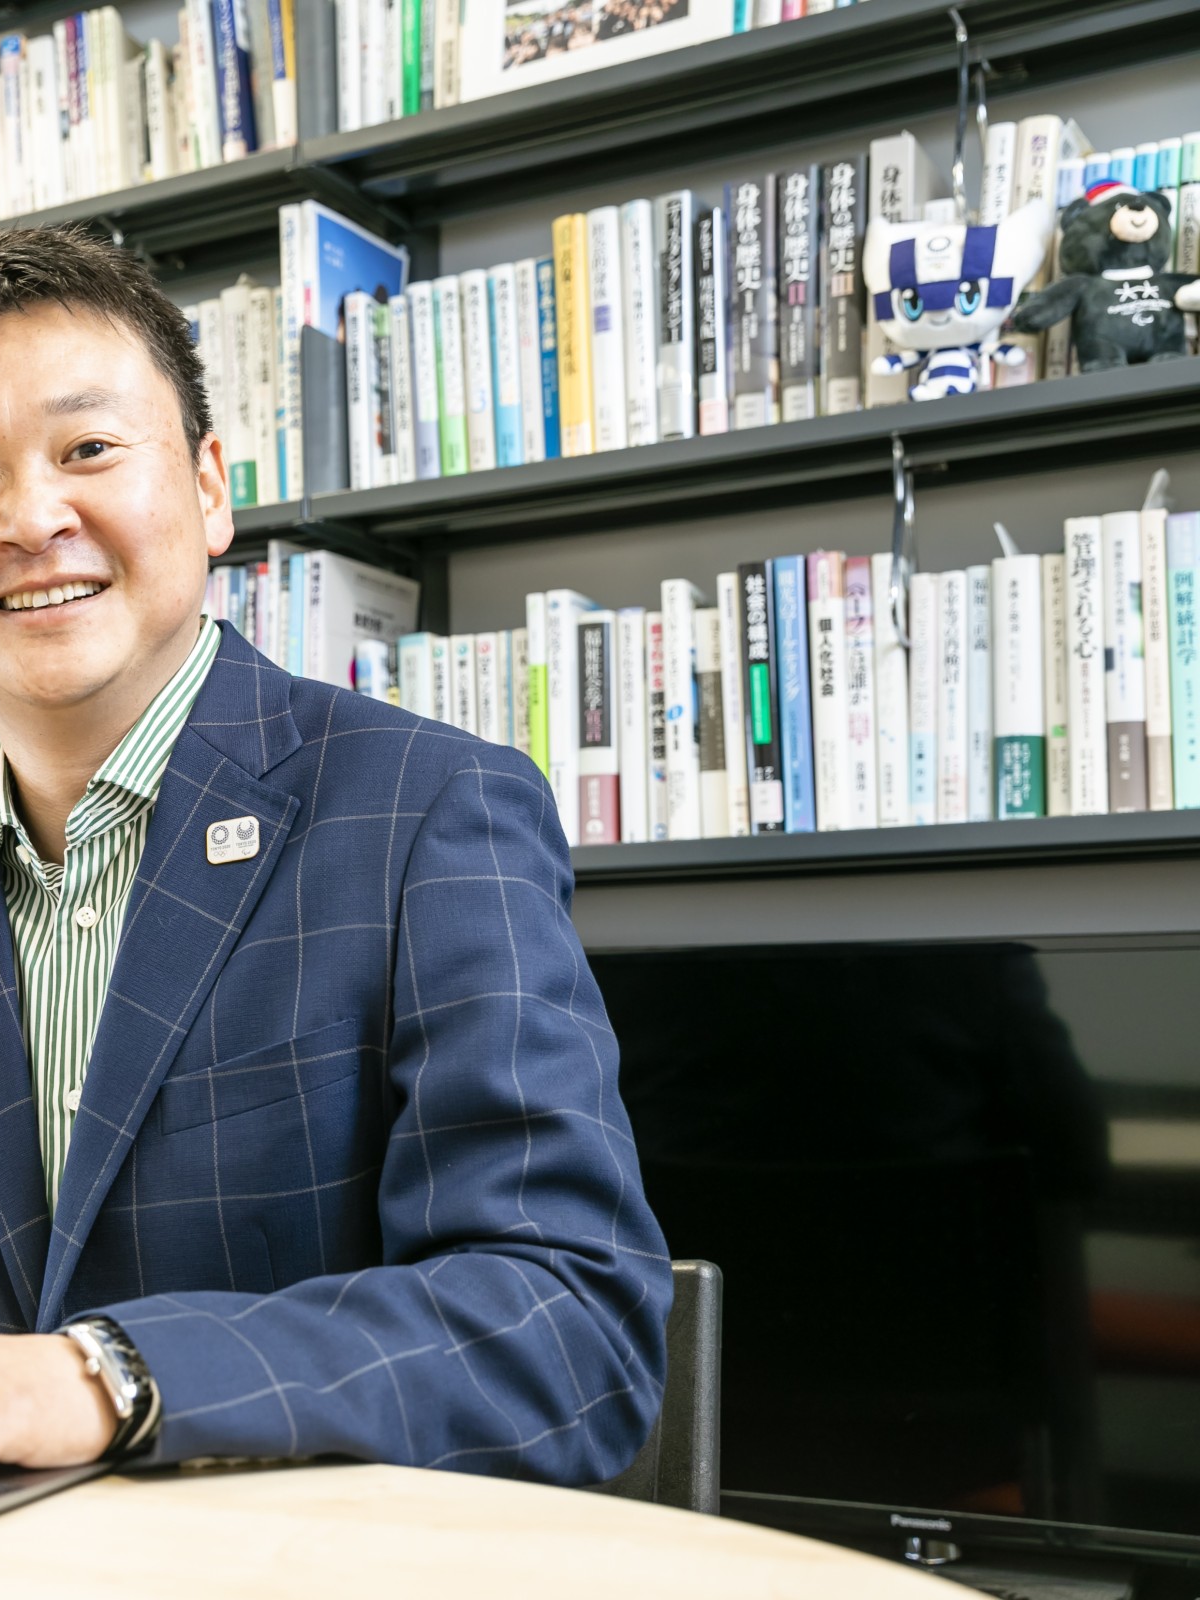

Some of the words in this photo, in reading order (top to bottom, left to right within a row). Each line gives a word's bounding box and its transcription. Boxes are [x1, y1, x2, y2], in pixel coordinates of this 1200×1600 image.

[736, 182, 761, 292] 身体の歴史
[784, 173, 810, 283] 身体の歴史
[829, 162, 855, 272] 身体の歴史
[745, 574, 770, 661] 社会の構成
[1071, 531, 1098, 661] 管理される心
[817, 617, 836, 697] 個人化社会
